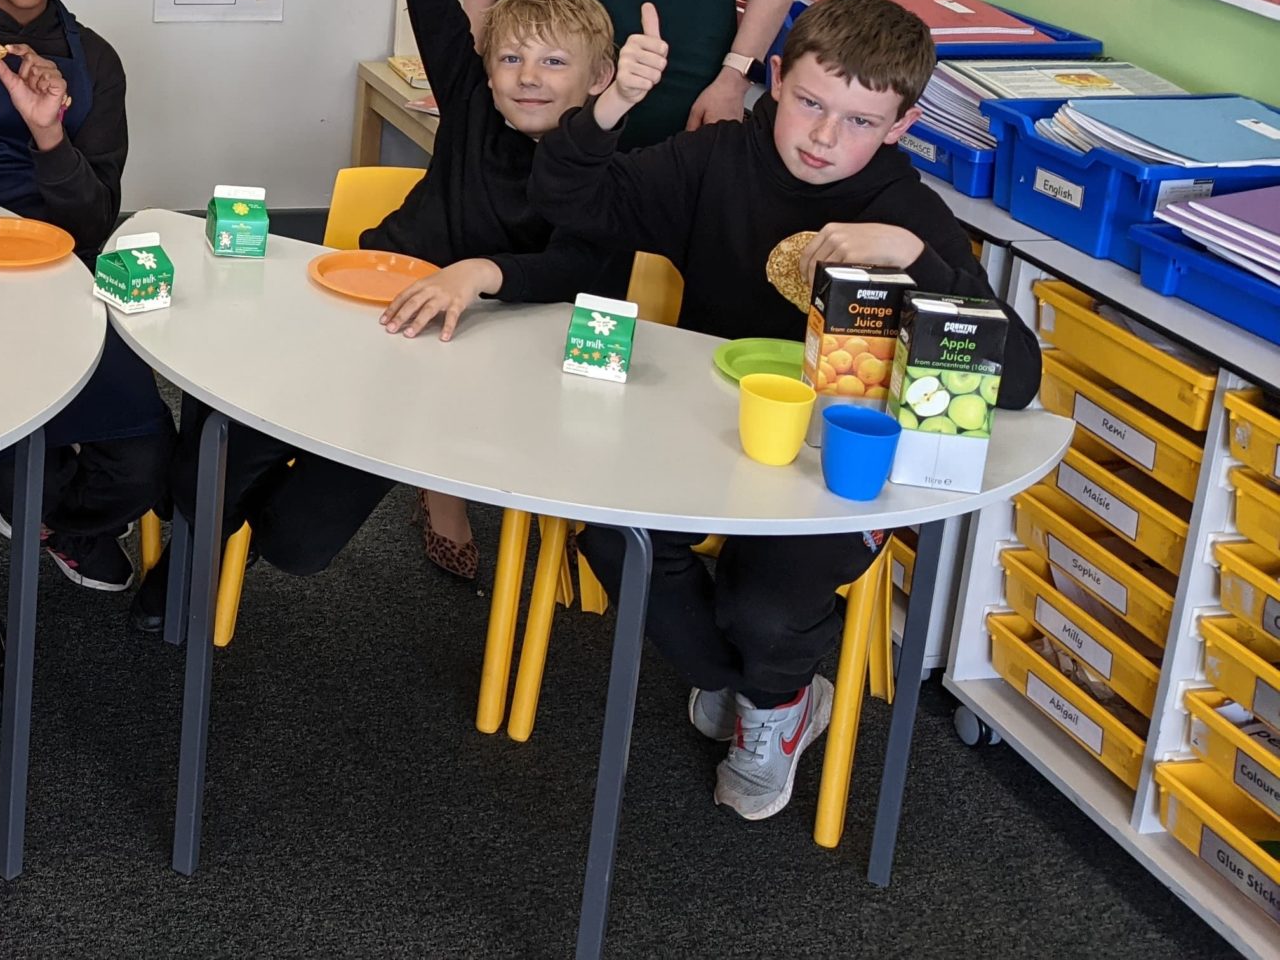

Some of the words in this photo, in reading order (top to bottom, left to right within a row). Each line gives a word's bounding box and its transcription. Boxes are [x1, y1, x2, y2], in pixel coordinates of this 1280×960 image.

[1043, 179, 1073, 202] English
[848, 303, 893, 317] Orange
[854, 316, 883, 328] Juice
[939, 336, 977, 351] Apple
[940, 350, 972, 362] Juice
[1101, 417, 1127, 440] Remi
[1082, 485, 1111, 511] Maisie
[1071, 558, 1102, 586] Sophie
[1062, 623, 1084, 648] Milly
[1049, 696, 1079, 726] Abigail
[1216, 849, 1244, 880] Glue
